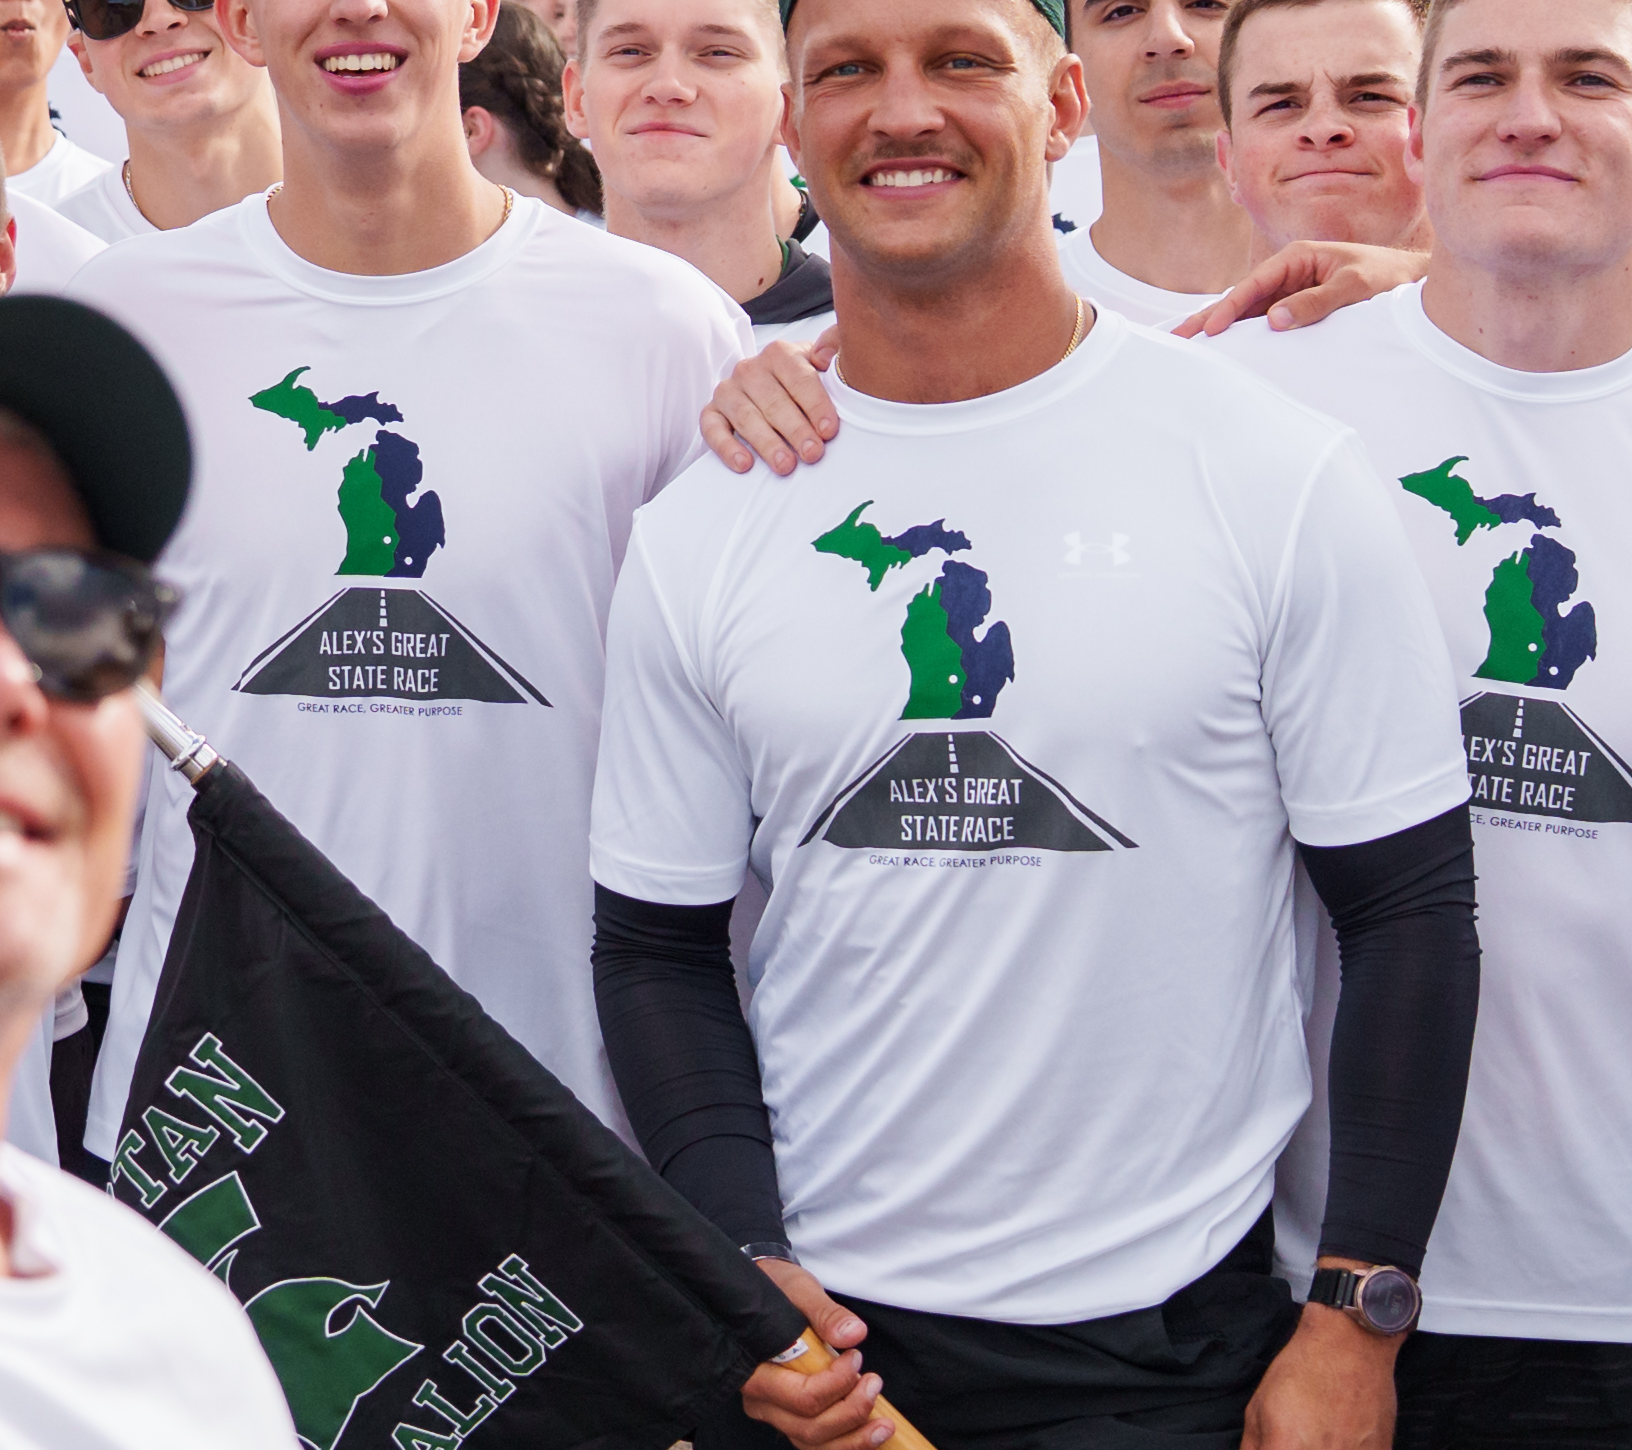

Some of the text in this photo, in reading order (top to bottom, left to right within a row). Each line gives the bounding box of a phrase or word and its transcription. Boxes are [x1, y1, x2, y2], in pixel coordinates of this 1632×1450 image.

[319, 630, 450, 658] ALEX'S GREAT
[328, 666, 439, 693] STATE RACE
[297, 703, 330, 714] GREAT
[370, 703, 415, 716] GREATER
[418, 706, 463, 717] PURPOSE
[1469, 736, 1591, 776] EX'S GREAT
[890, 777, 1023, 805] ALEX'S GREAT
[1467, 772, 1575, 811] TATE RACE
[900, 815, 1015, 842] STATE RACE
[1490, 816, 1541, 832] GREATER
[1545, 823, 1599, 839] PURPOSE
[869, 855, 900, 866] GREAT
[939, 857, 986, 868] GREATER
[990, 855, 1042, 867] PURPOSE
